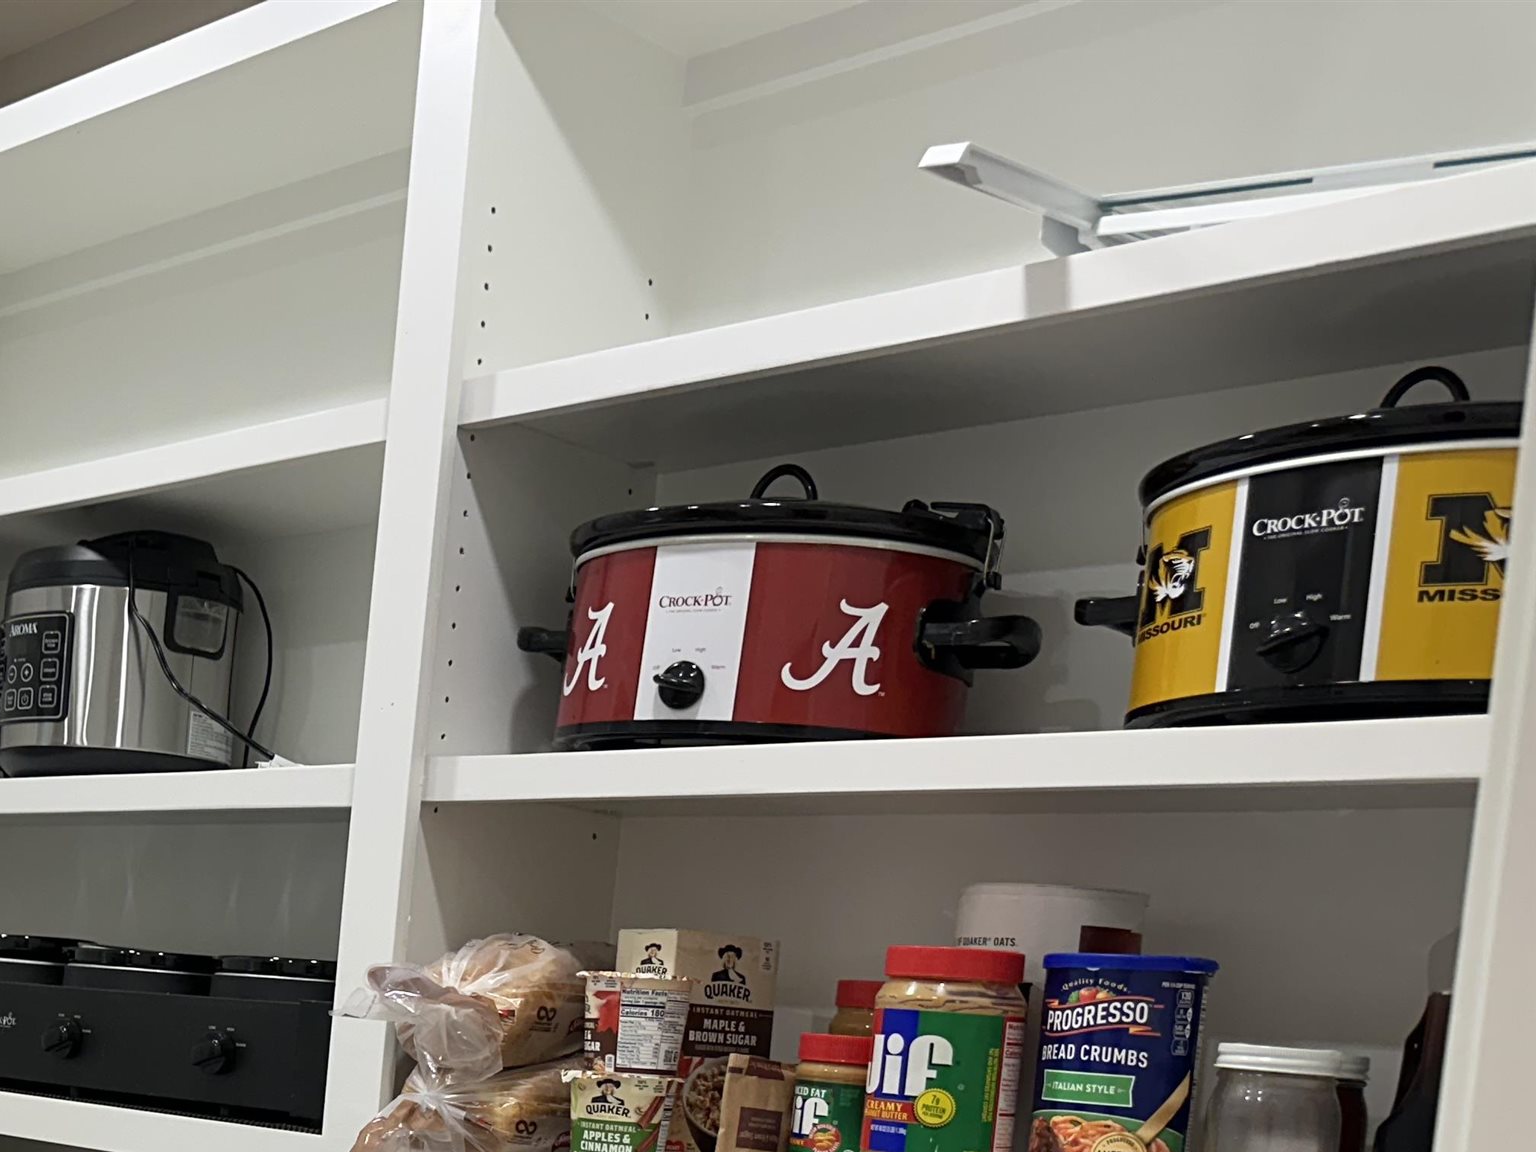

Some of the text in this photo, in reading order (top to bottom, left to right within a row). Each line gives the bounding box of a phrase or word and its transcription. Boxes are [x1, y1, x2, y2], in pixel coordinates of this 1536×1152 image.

[1417, 588, 1501, 602] MISS
[781, 599, 889, 695] A
[993, 937, 1016, 946] OATS
[1062, 978, 1129, 991] Quality Foods
[704, 983, 751, 1002] QUAKER
[620, 1009, 664, 1017] Calories 180
[1047, 1001, 1150, 1032] PROGRESSO
[703, 1018, 746, 1032] MAPLE &
[688, 1030, 757, 1047] BROWN SUGAR
[584, 1041, 601, 1052] GAR
[1041, 1043, 1149, 1068] BREAD CRUMBS
[865, 1032, 954, 1097] Jif
[810, 1088, 828, 1098] FAT
[1052, 1081, 1116, 1094] ITALIAN STYLE
[585, 1104, 630, 1118] QUAKER
[793, 1095, 829, 1135] if
[881, 1109, 908, 1121] BUTTER
[580, 1121, 637, 1133] INSTANT OATMEAL
[582, 1130, 631, 1144] APPLES &
